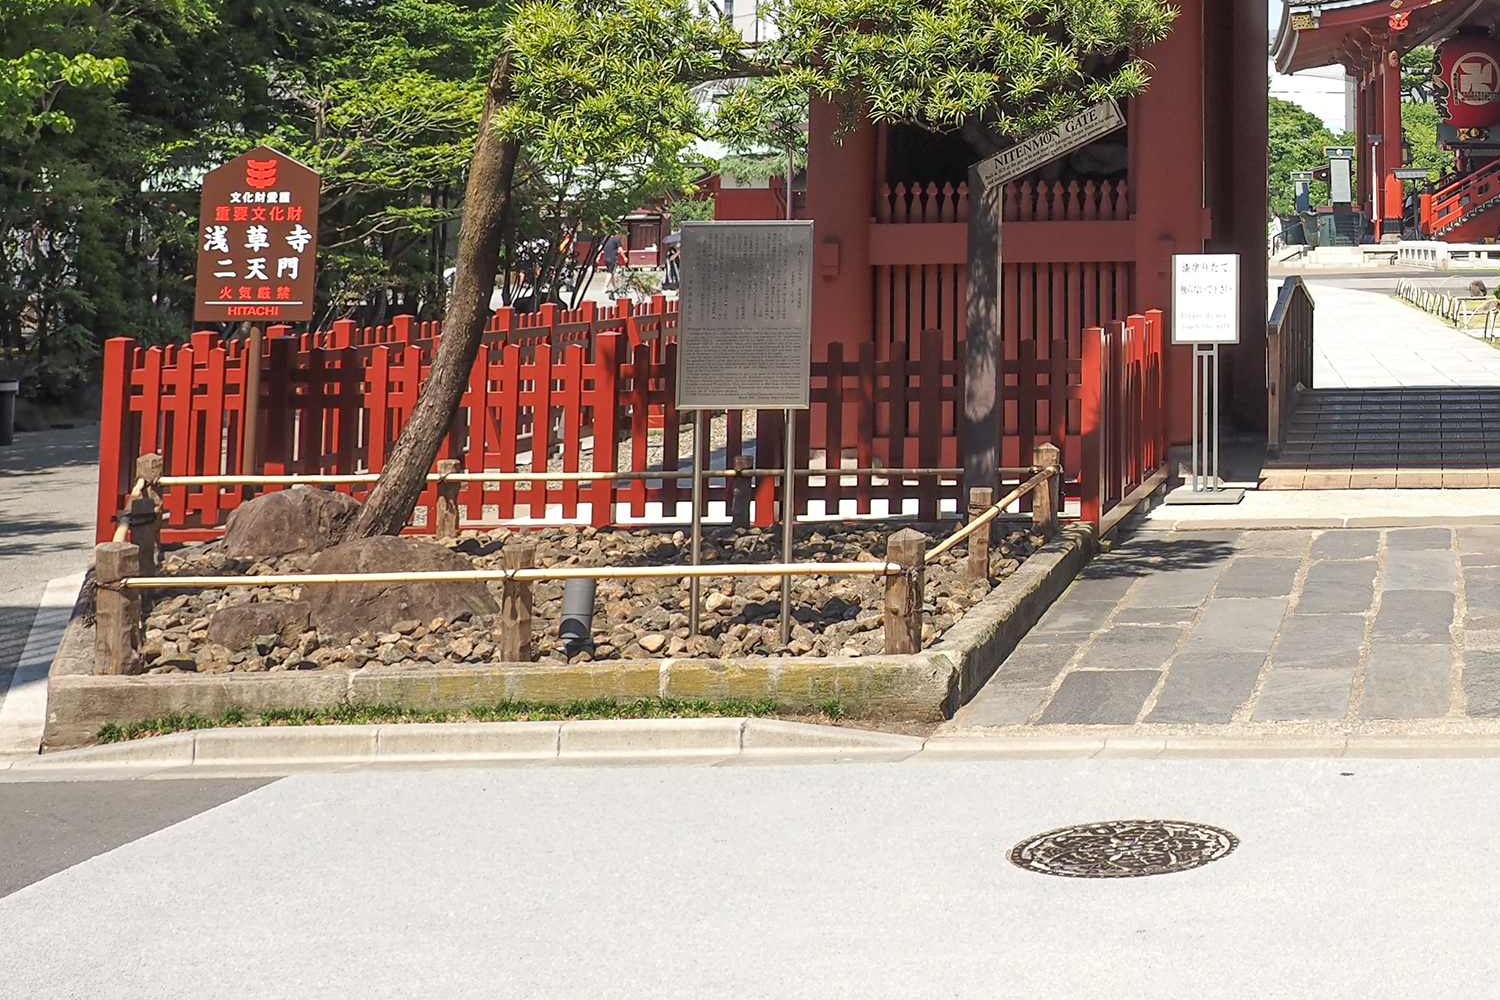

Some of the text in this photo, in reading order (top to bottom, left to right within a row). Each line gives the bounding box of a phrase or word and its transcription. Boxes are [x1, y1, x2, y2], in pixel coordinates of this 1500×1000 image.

[1065, 109, 1098, 133] GATE
[229, 191, 291, 204] 文化財愛護
[215, 206, 303, 222] 重要文化財
[203, 223, 313, 254] 浅草寺
[213, 257, 299, 281] 二天門
[219, 285, 292, 300] 火気厳禁
[227, 306, 280, 316] HITACHI
